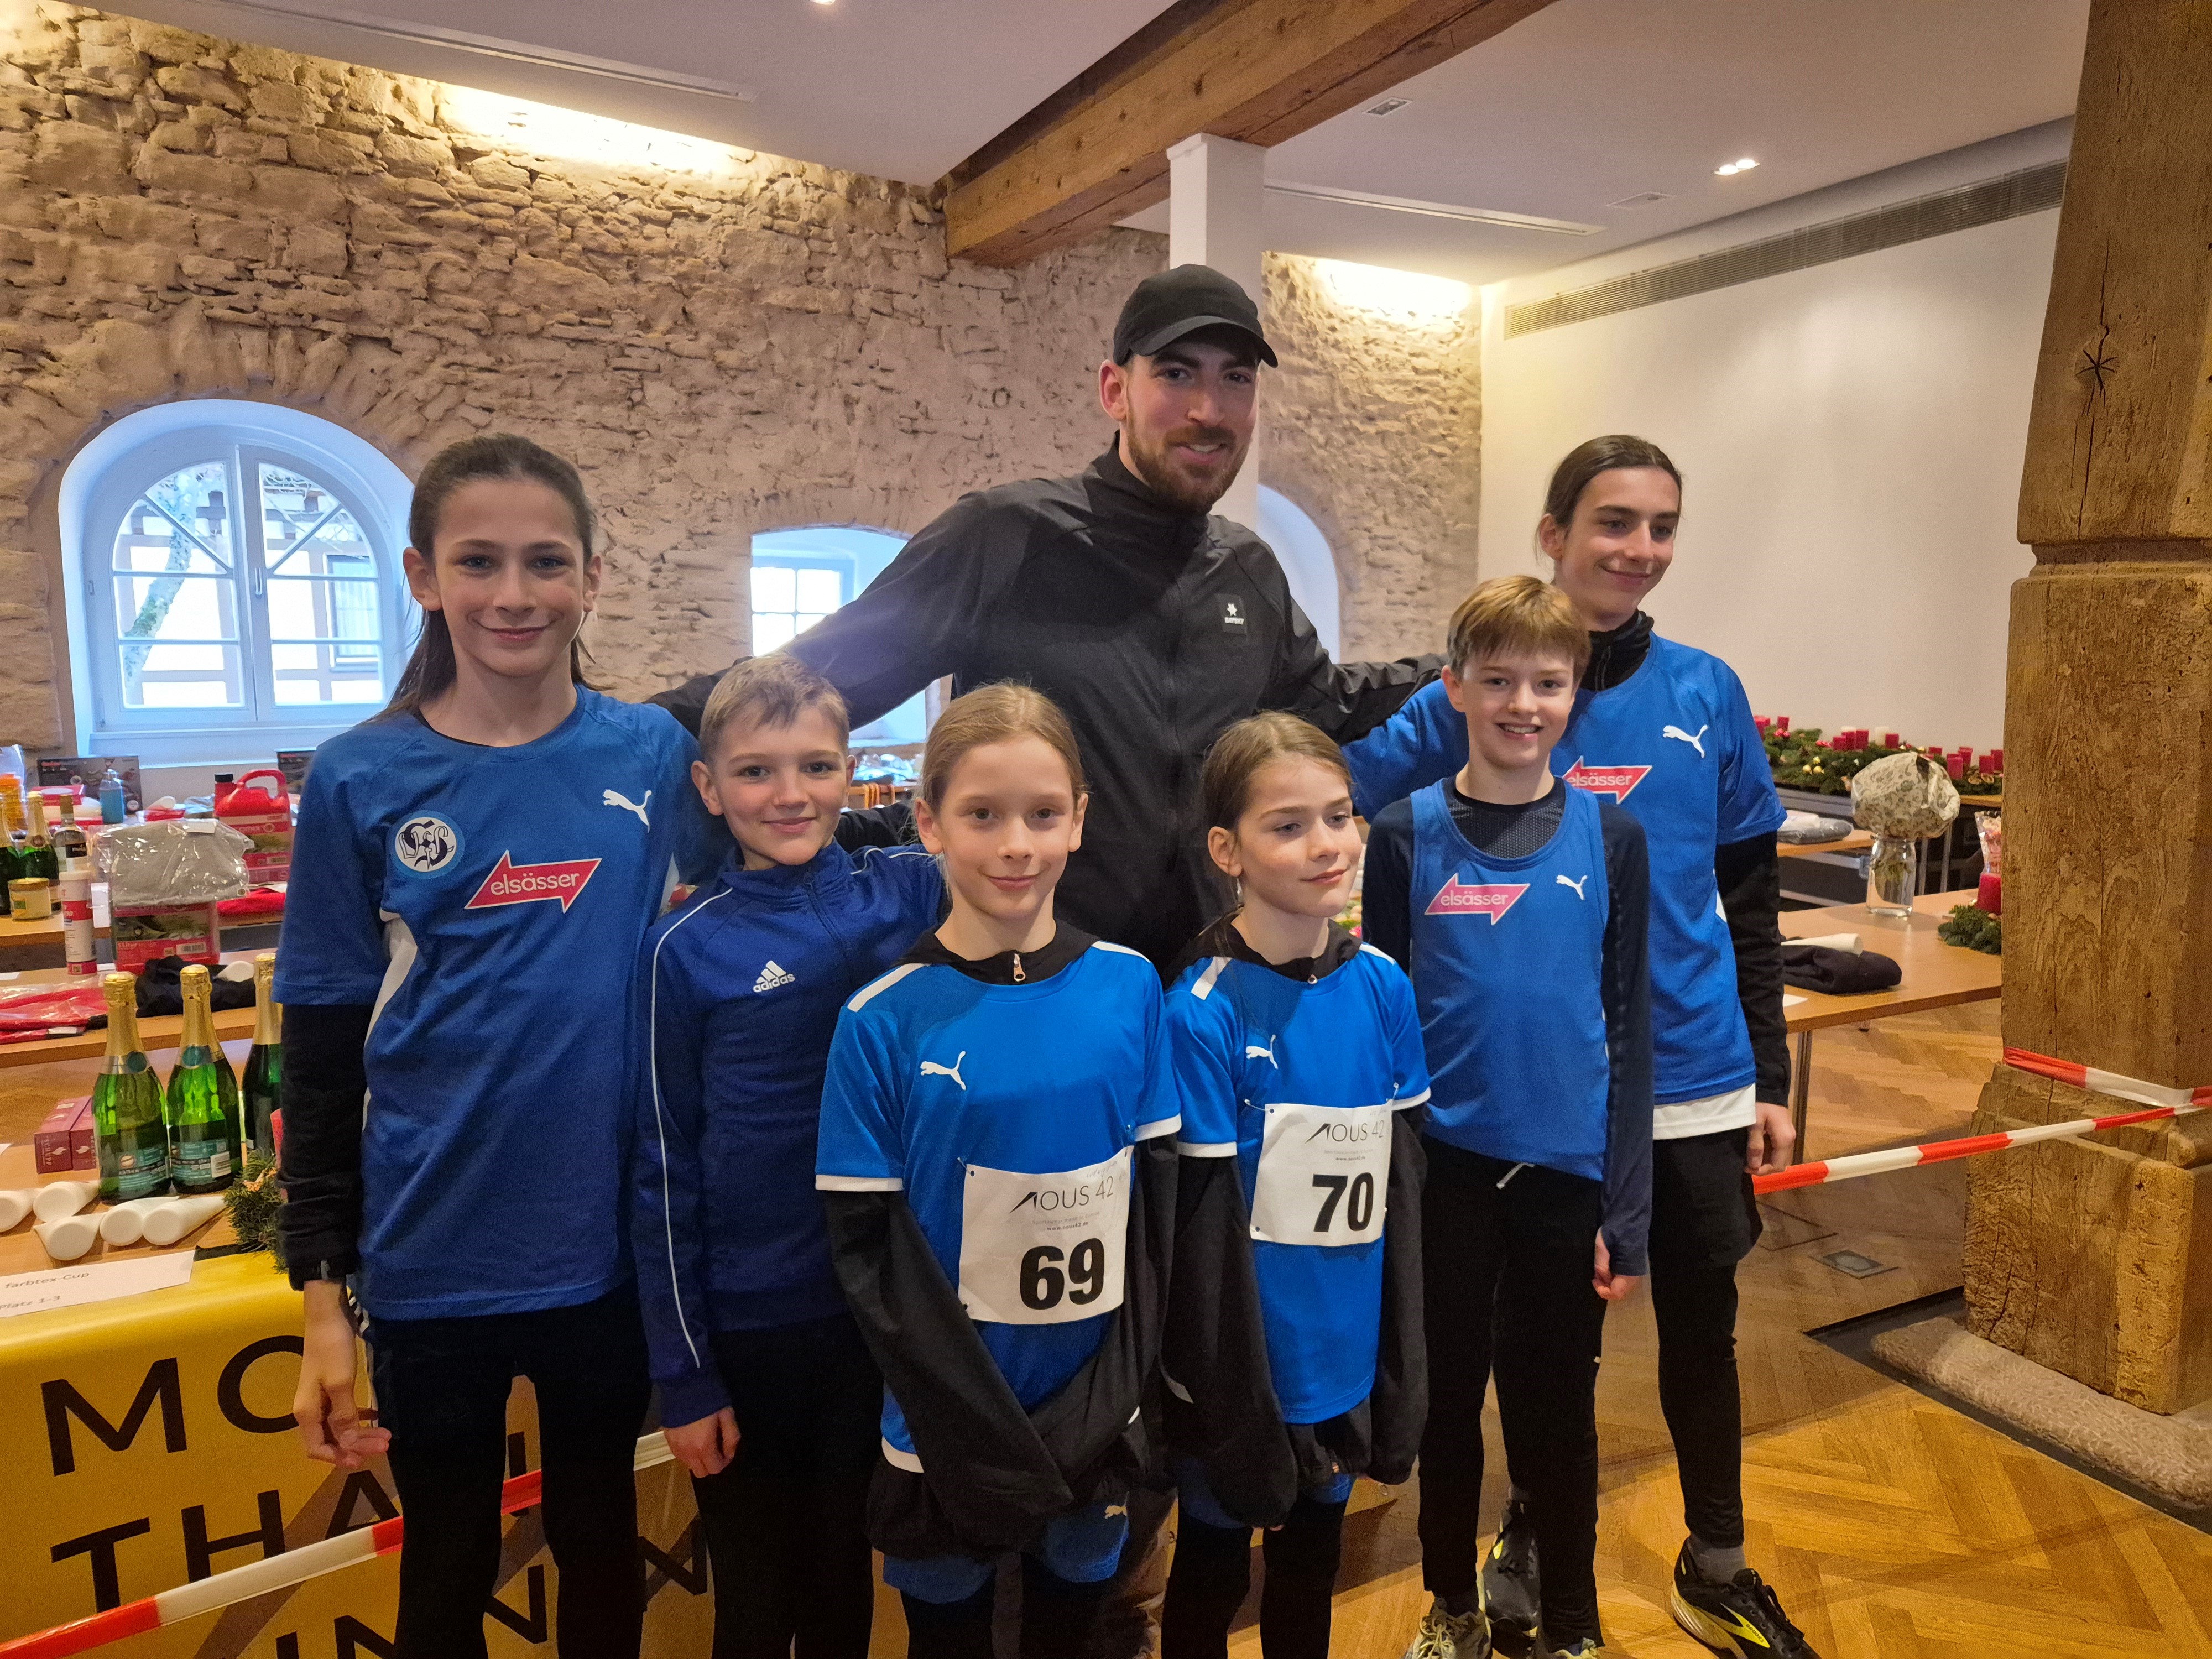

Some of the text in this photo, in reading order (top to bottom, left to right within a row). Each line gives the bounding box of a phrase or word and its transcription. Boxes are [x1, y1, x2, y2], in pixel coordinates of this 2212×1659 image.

[1567, 772, 1632, 787] elsässer
[491, 872, 580, 895] elsässer
[1441, 890, 1509, 906] elsässer
[753, 973, 795, 993] adidas
[1371, 1120, 1384, 1138] 42
[1095, 1176, 1114, 1199] 42
[1311, 1171, 1374, 1233] 70
[5, 1272, 90, 1288] farbtex-Cup
[1019, 1238, 1105, 1310] 69
